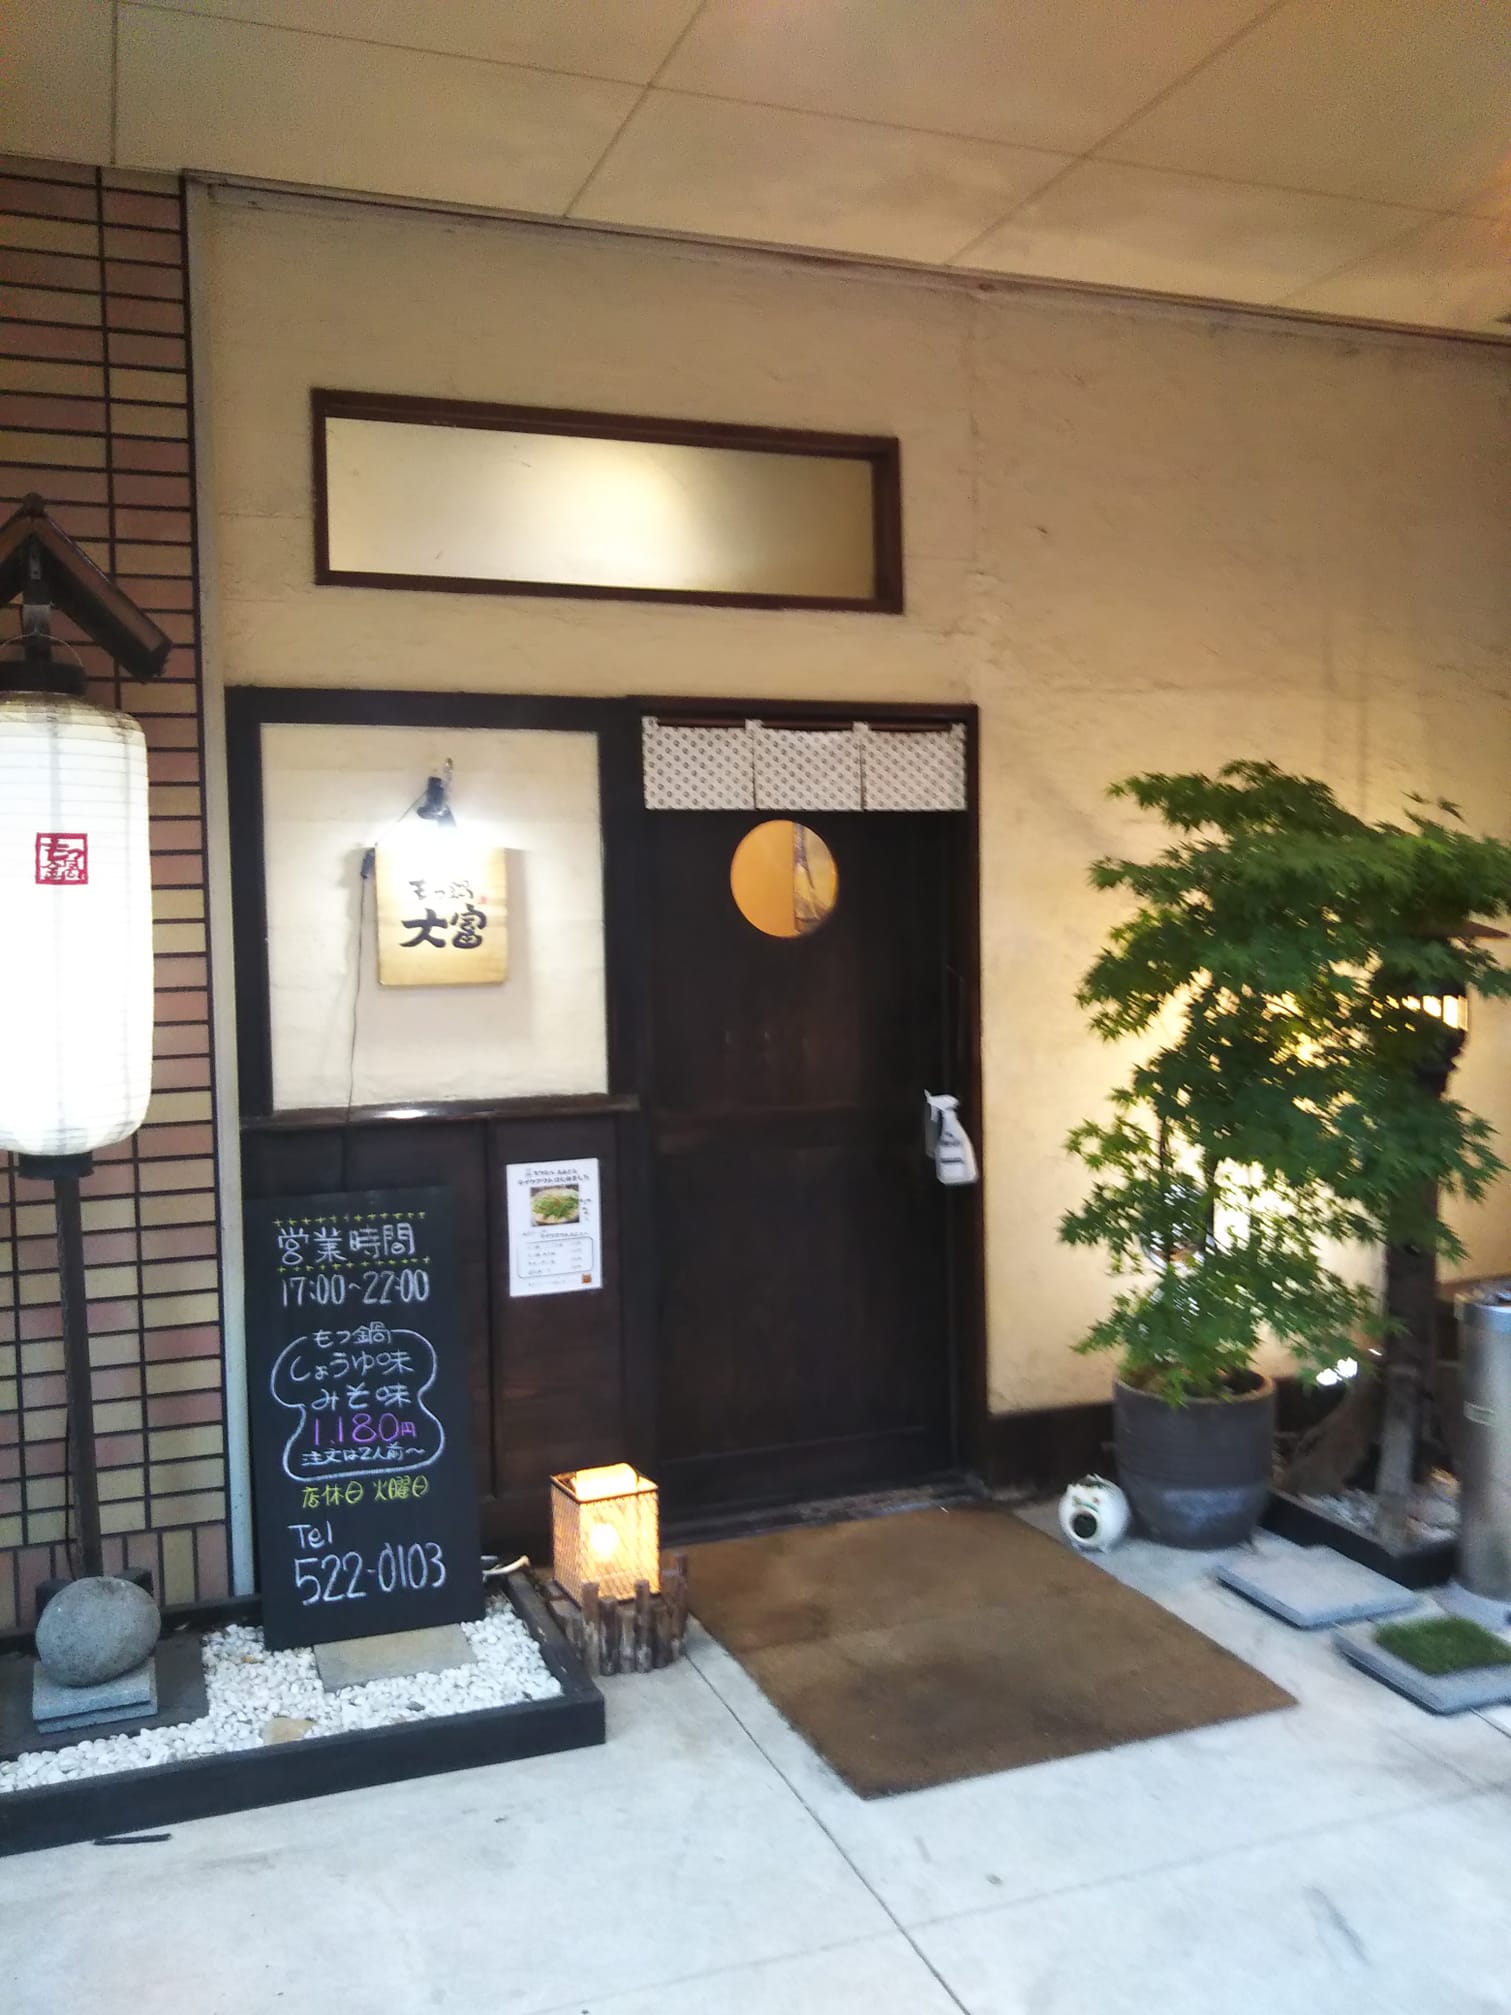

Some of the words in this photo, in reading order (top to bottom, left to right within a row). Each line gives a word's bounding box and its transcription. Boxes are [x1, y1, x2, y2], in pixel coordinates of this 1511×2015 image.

[400, 903, 488, 949] 大富
[277, 1222, 417, 1265] 営業時間
[312, 1321, 392, 1348] もつ鍋
[289, 1349, 415, 1381] しょうゆ味
[311, 1382, 411, 1411] みそ味
[302, 1480, 364, 1509] 店休日
[373, 1475, 430, 1501] 火曜日
[288, 1521, 333, 1549] Tel
[294, 1542, 447, 1606] 522-0103
